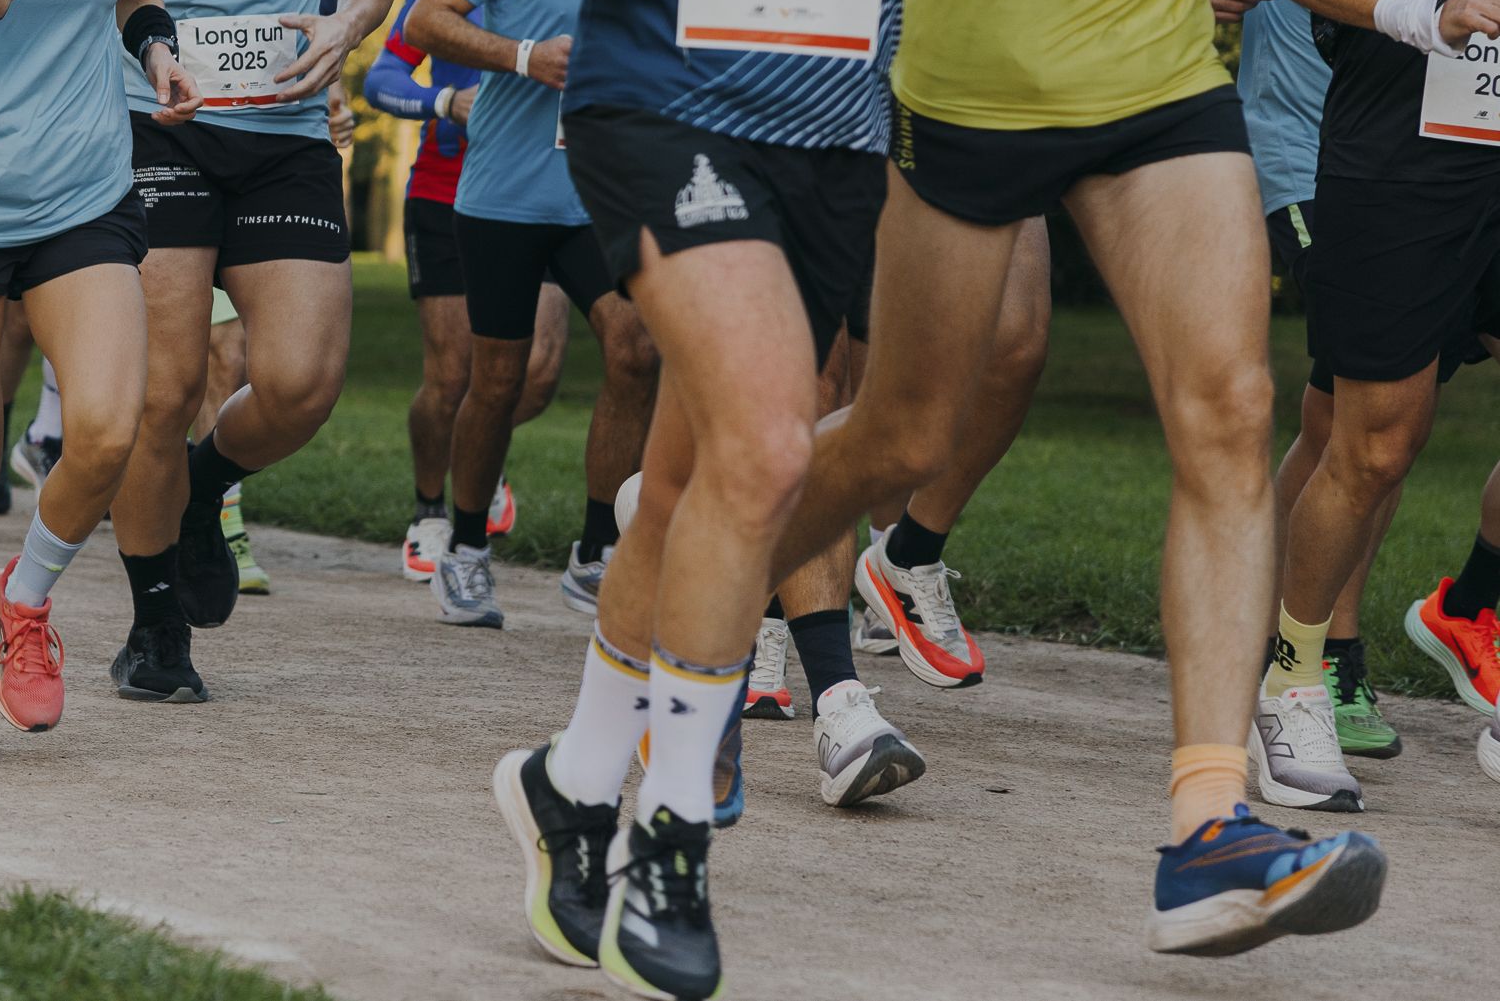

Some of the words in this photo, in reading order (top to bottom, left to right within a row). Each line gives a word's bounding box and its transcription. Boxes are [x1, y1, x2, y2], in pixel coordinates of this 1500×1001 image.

[195, 26, 248, 48] Long
[255, 26, 283, 42] run
[218, 50, 268, 72] 2025
